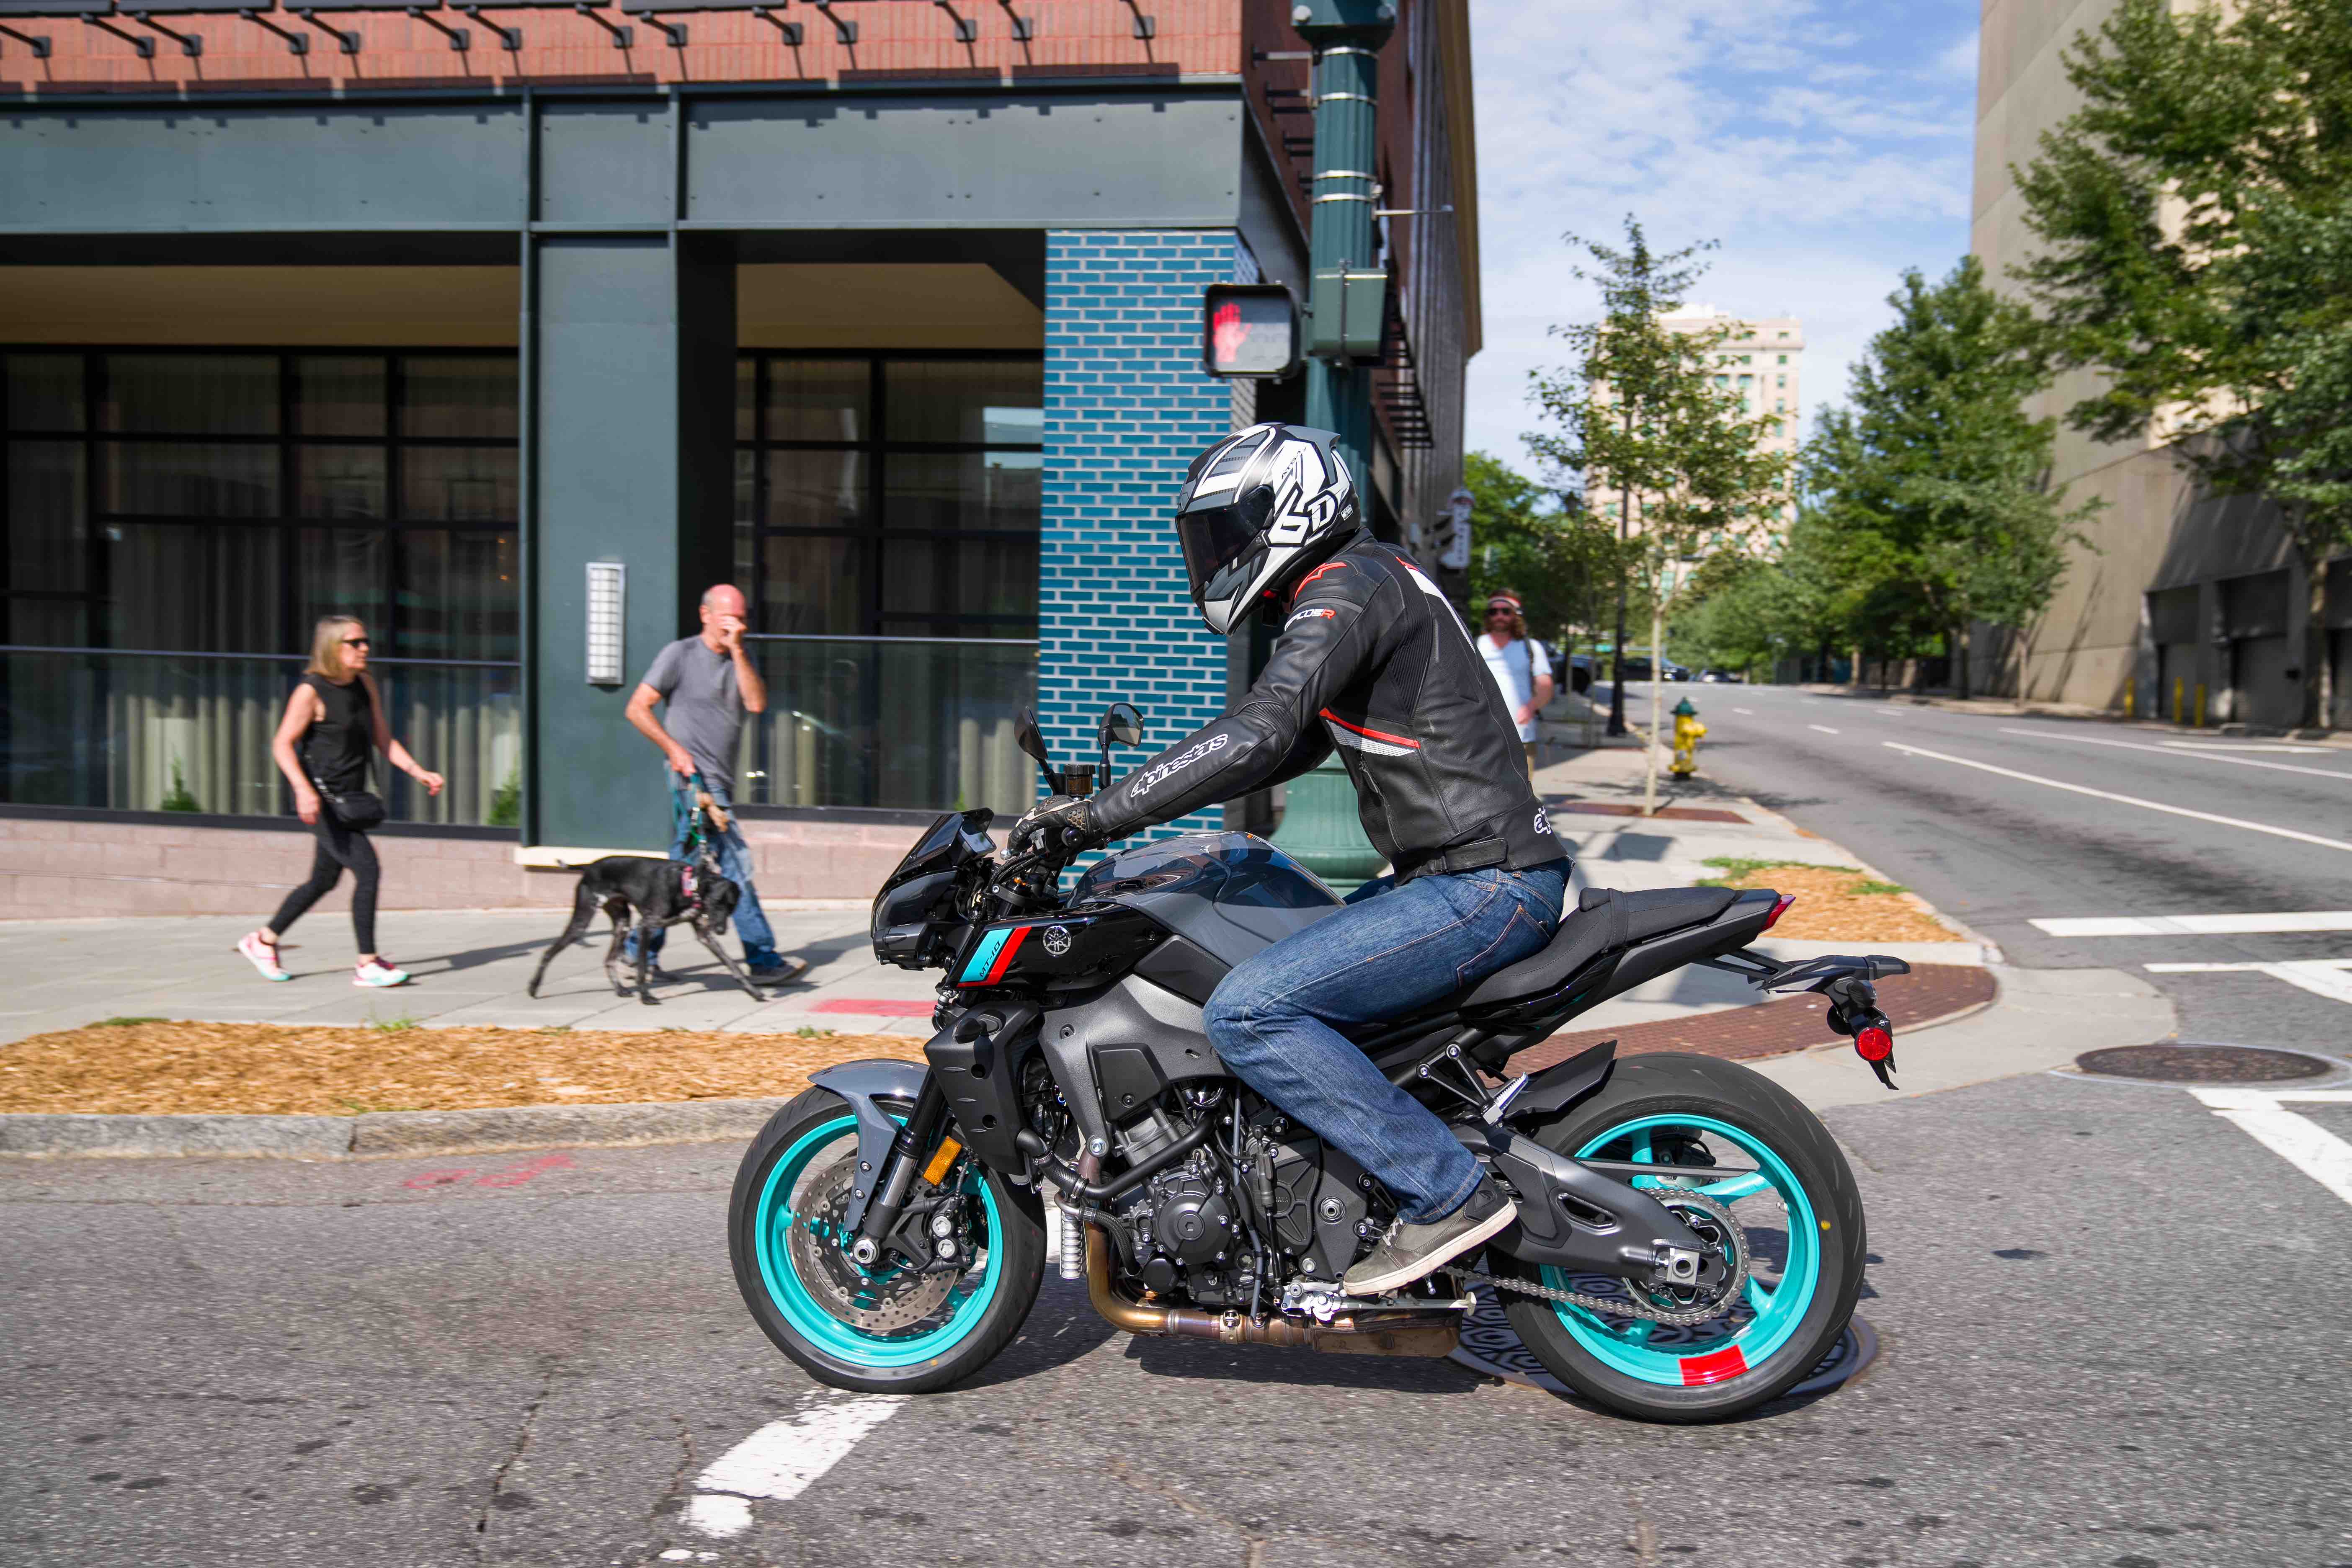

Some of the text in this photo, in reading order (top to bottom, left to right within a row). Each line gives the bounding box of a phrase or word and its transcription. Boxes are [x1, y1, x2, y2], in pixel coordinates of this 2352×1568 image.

[1266, 488, 1336, 544] 6D
[1130, 734, 1228, 798] alpinestars
[980, 940, 1001, 977] MT-10
